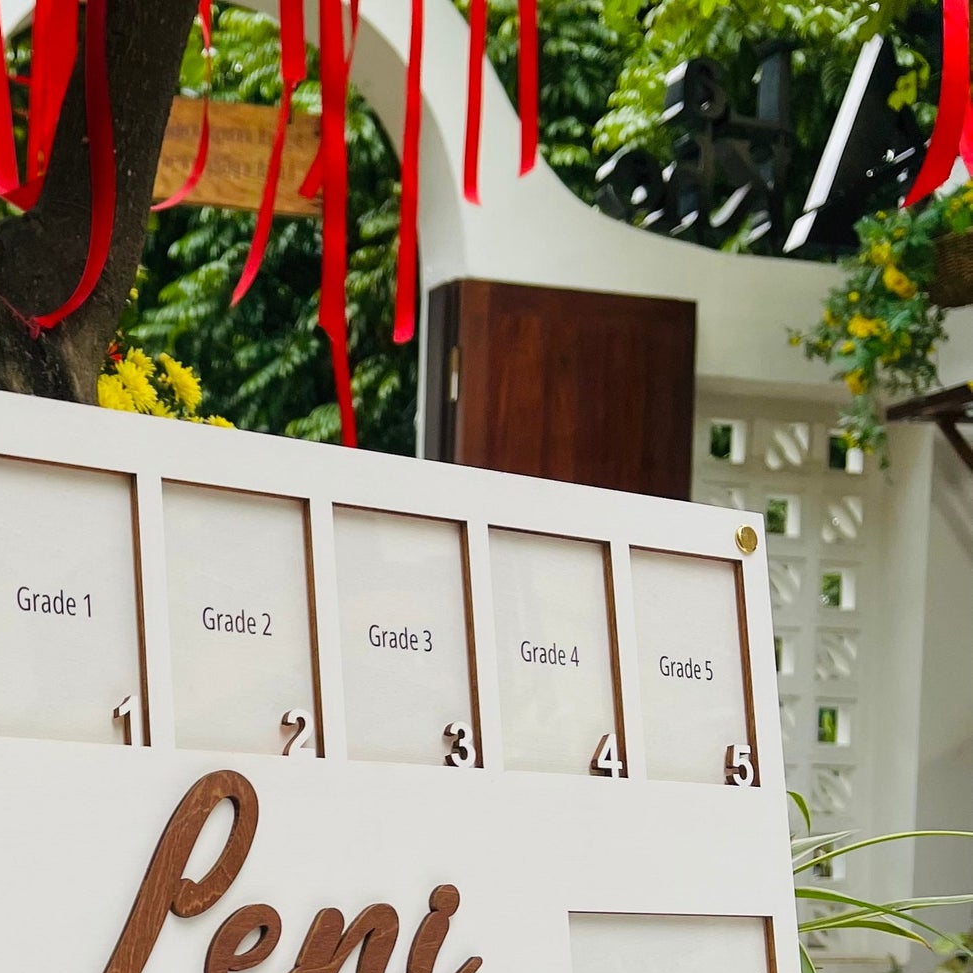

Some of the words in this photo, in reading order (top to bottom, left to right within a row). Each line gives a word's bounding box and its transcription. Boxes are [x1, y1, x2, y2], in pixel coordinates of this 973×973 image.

[16, 586, 77, 617] Grade
[83, 593, 92, 618] 1
[202, 606, 257, 635] Grade
[261, 612, 273, 637] 2
[368, 624, 419, 651] Grade
[422, 629, 433, 653] 3
[520, 640, 566, 666] Grade
[570, 645, 580, 668] 4
[659, 655, 702, 680] Grade
[704, 660, 714, 681] 5
[113, 695, 141, 747] 1
[281, 708, 316, 758] 2
[443, 721, 476, 768] 3
[590, 733, 623, 778] 4
[726, 744, 755, 788] 5
